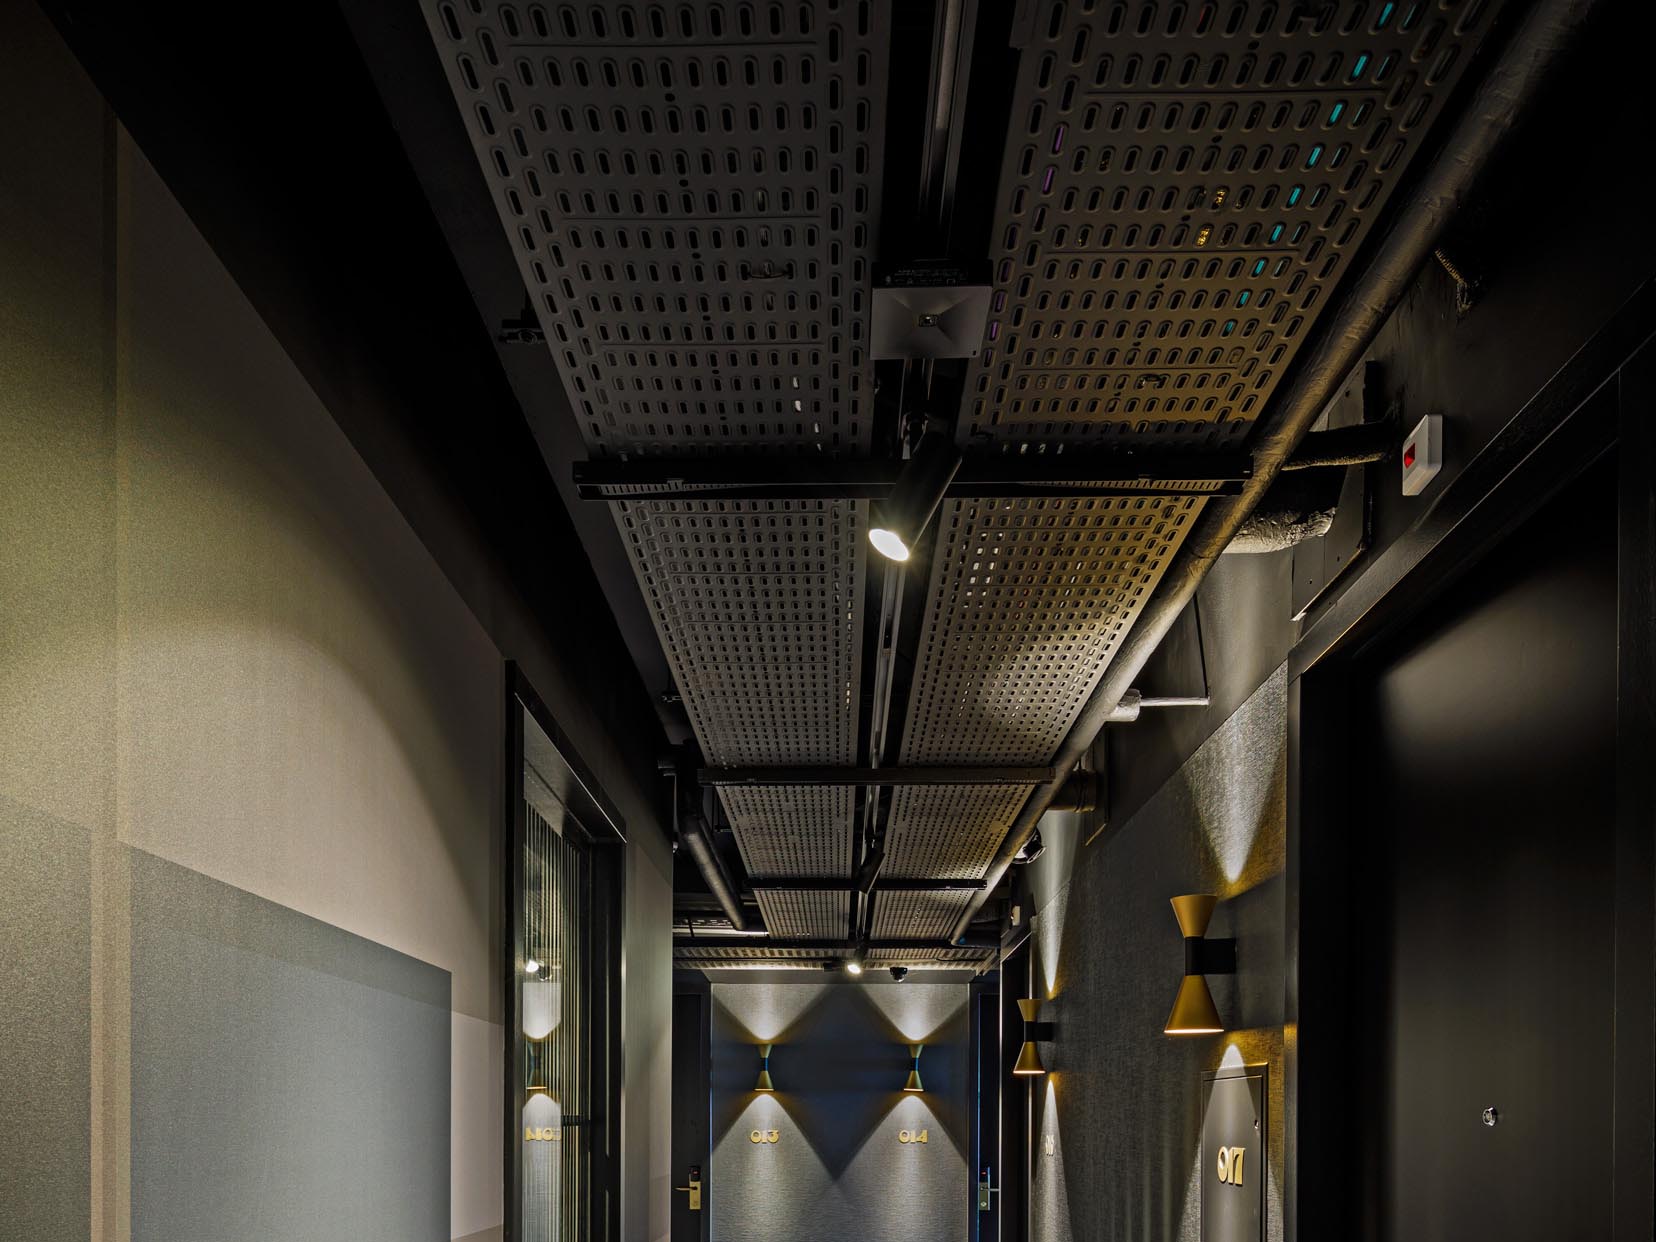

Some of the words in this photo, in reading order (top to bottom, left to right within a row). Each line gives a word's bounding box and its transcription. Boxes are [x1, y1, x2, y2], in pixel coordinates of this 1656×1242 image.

[751, 1130, 779, 1143] 013
[899, 1130, 928, 1143] 014
[1217, 1146, 1246, 1186] 017
